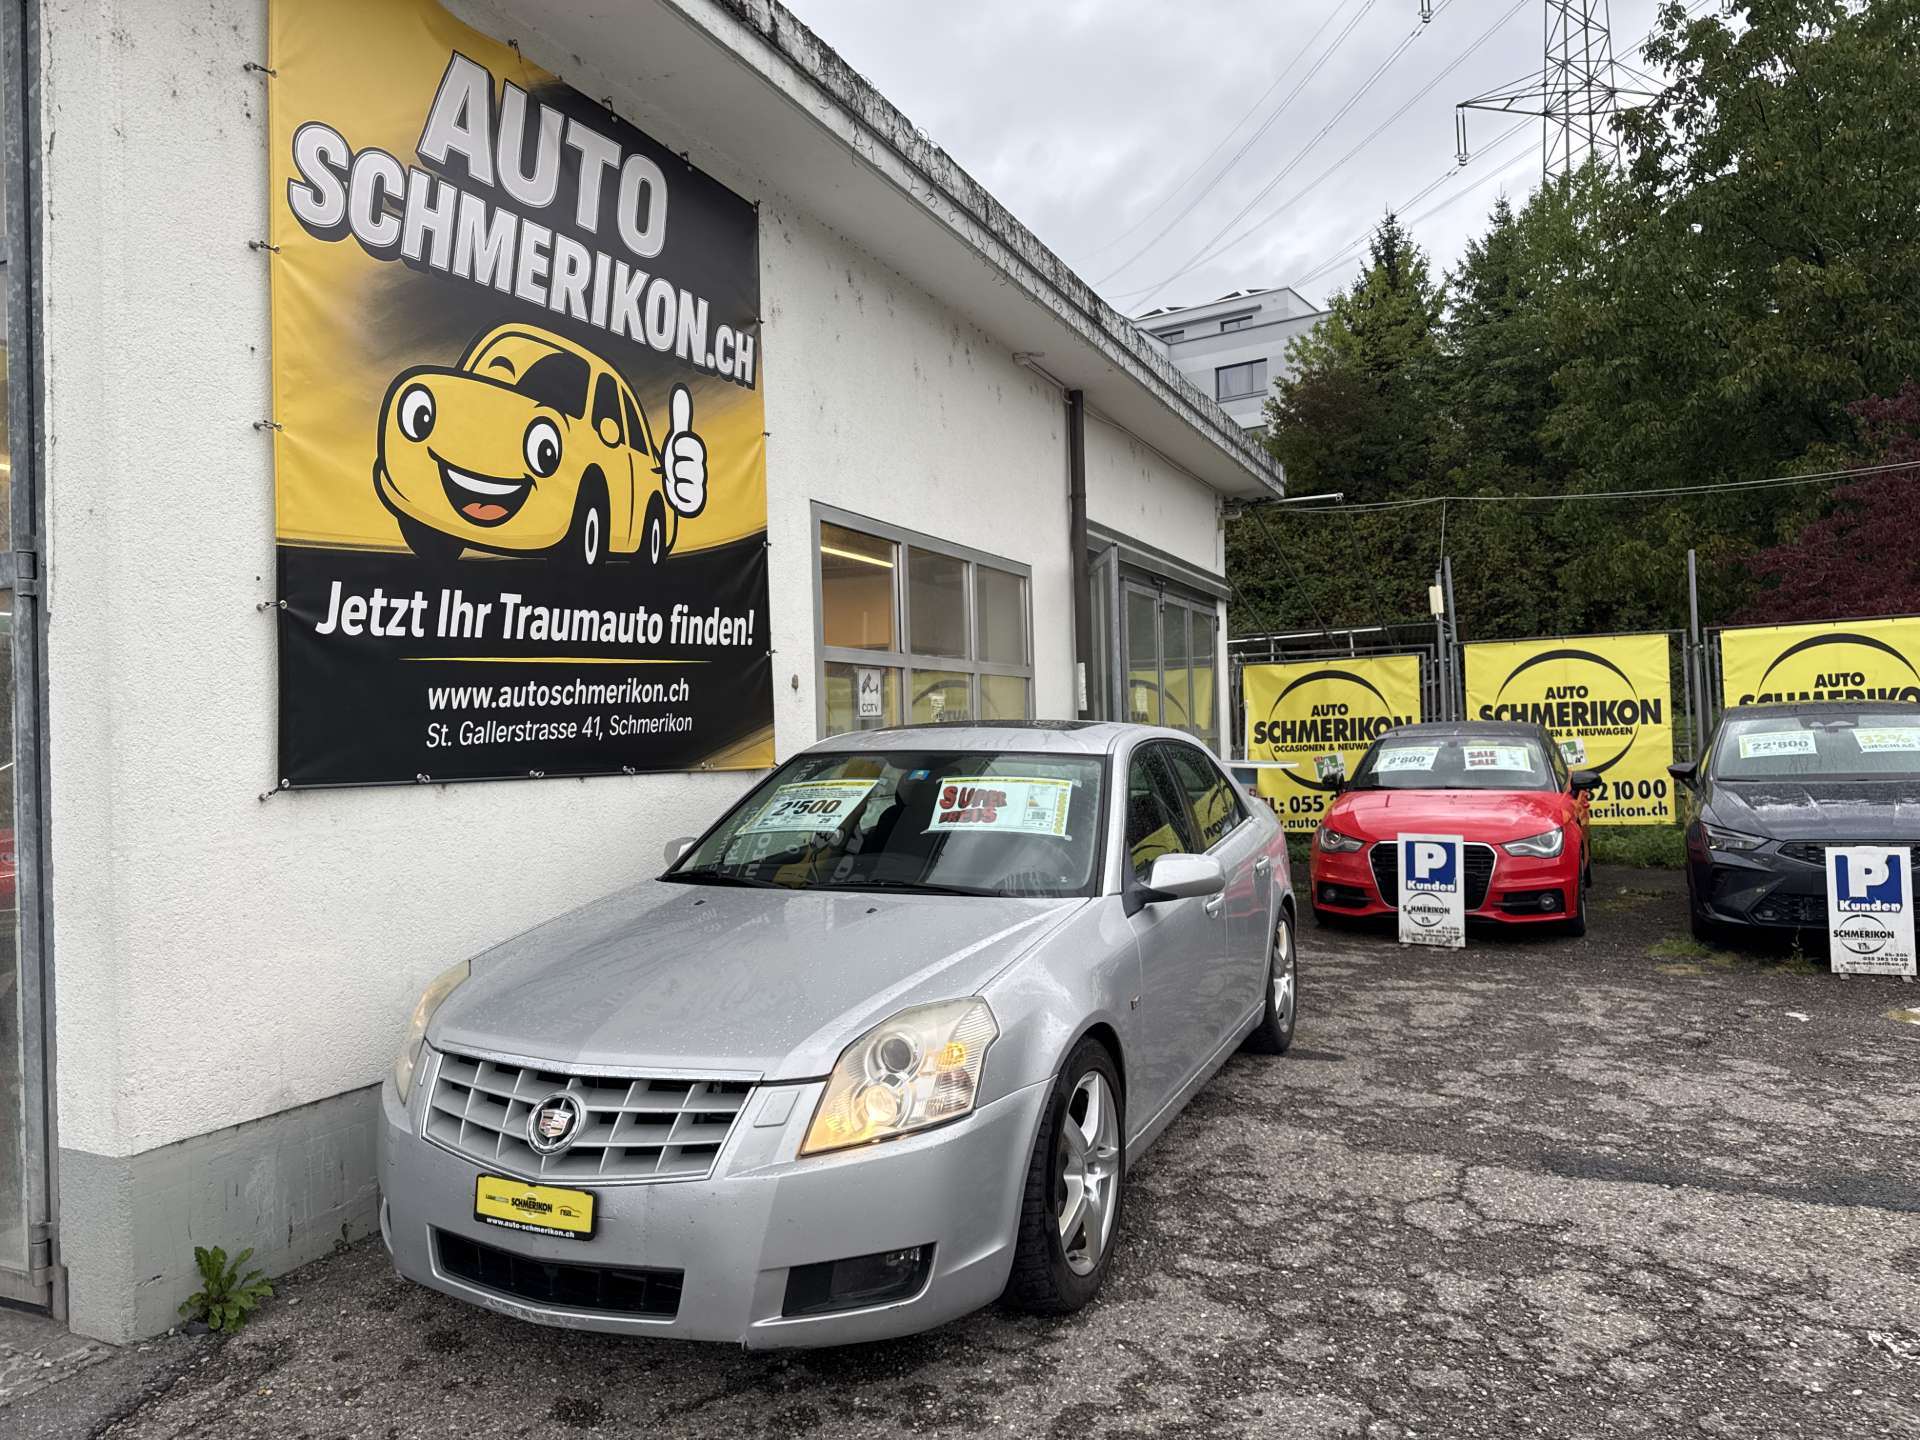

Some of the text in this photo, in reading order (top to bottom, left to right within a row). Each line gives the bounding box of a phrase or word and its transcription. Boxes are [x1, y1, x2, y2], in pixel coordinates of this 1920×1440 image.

[415, 51, 668, 258] AUTO
[288, 123, 757, 386] SCHMERIKON.CH
[315, 581, 754, 646] Jetzt Ihr Traumauto finden!
[1814, 672, 1865, 689] AUTO
[428, 678, 689, 710] www.autoschmerikon.ch
[1545, 686, 1589, 700] AUTO
[862, 703, 879, 712] CCTV
[1311, 704, 1349, 717] AUTO
[1479, 698, 1662, 727] SCHMERIKON
[426, 714, 692, 747] St. Gallerstrasse 41, Schmerikon
[1566, 729, 1574, 737] &
[1577, 727, 1633, 737] NEUWAGEN
[1274, 743, 1326, 752] OCCASIONEN
[1328, 743, 1335, 751] &
[1469, 759, 1498, 767] SALE
[772, 800, 842, 815] 2'500
[1290, 795, 1325, 813] 055
[1414, 843, 1447, 879] P
[1847, 852, 1890, 898] P
[1407, 879, 1456, 891] Kunden
[1402, 904, 1450, 915] SHMERIKON
[1839, 899, 1901, 911] Kunden
[1833, 929, 1895, 939] SCHMERIKON
[511, 1197, 553, 1213] SCHMERIKON
[487, 1217, 575, 1238] www.auto-schmerikon.ch
